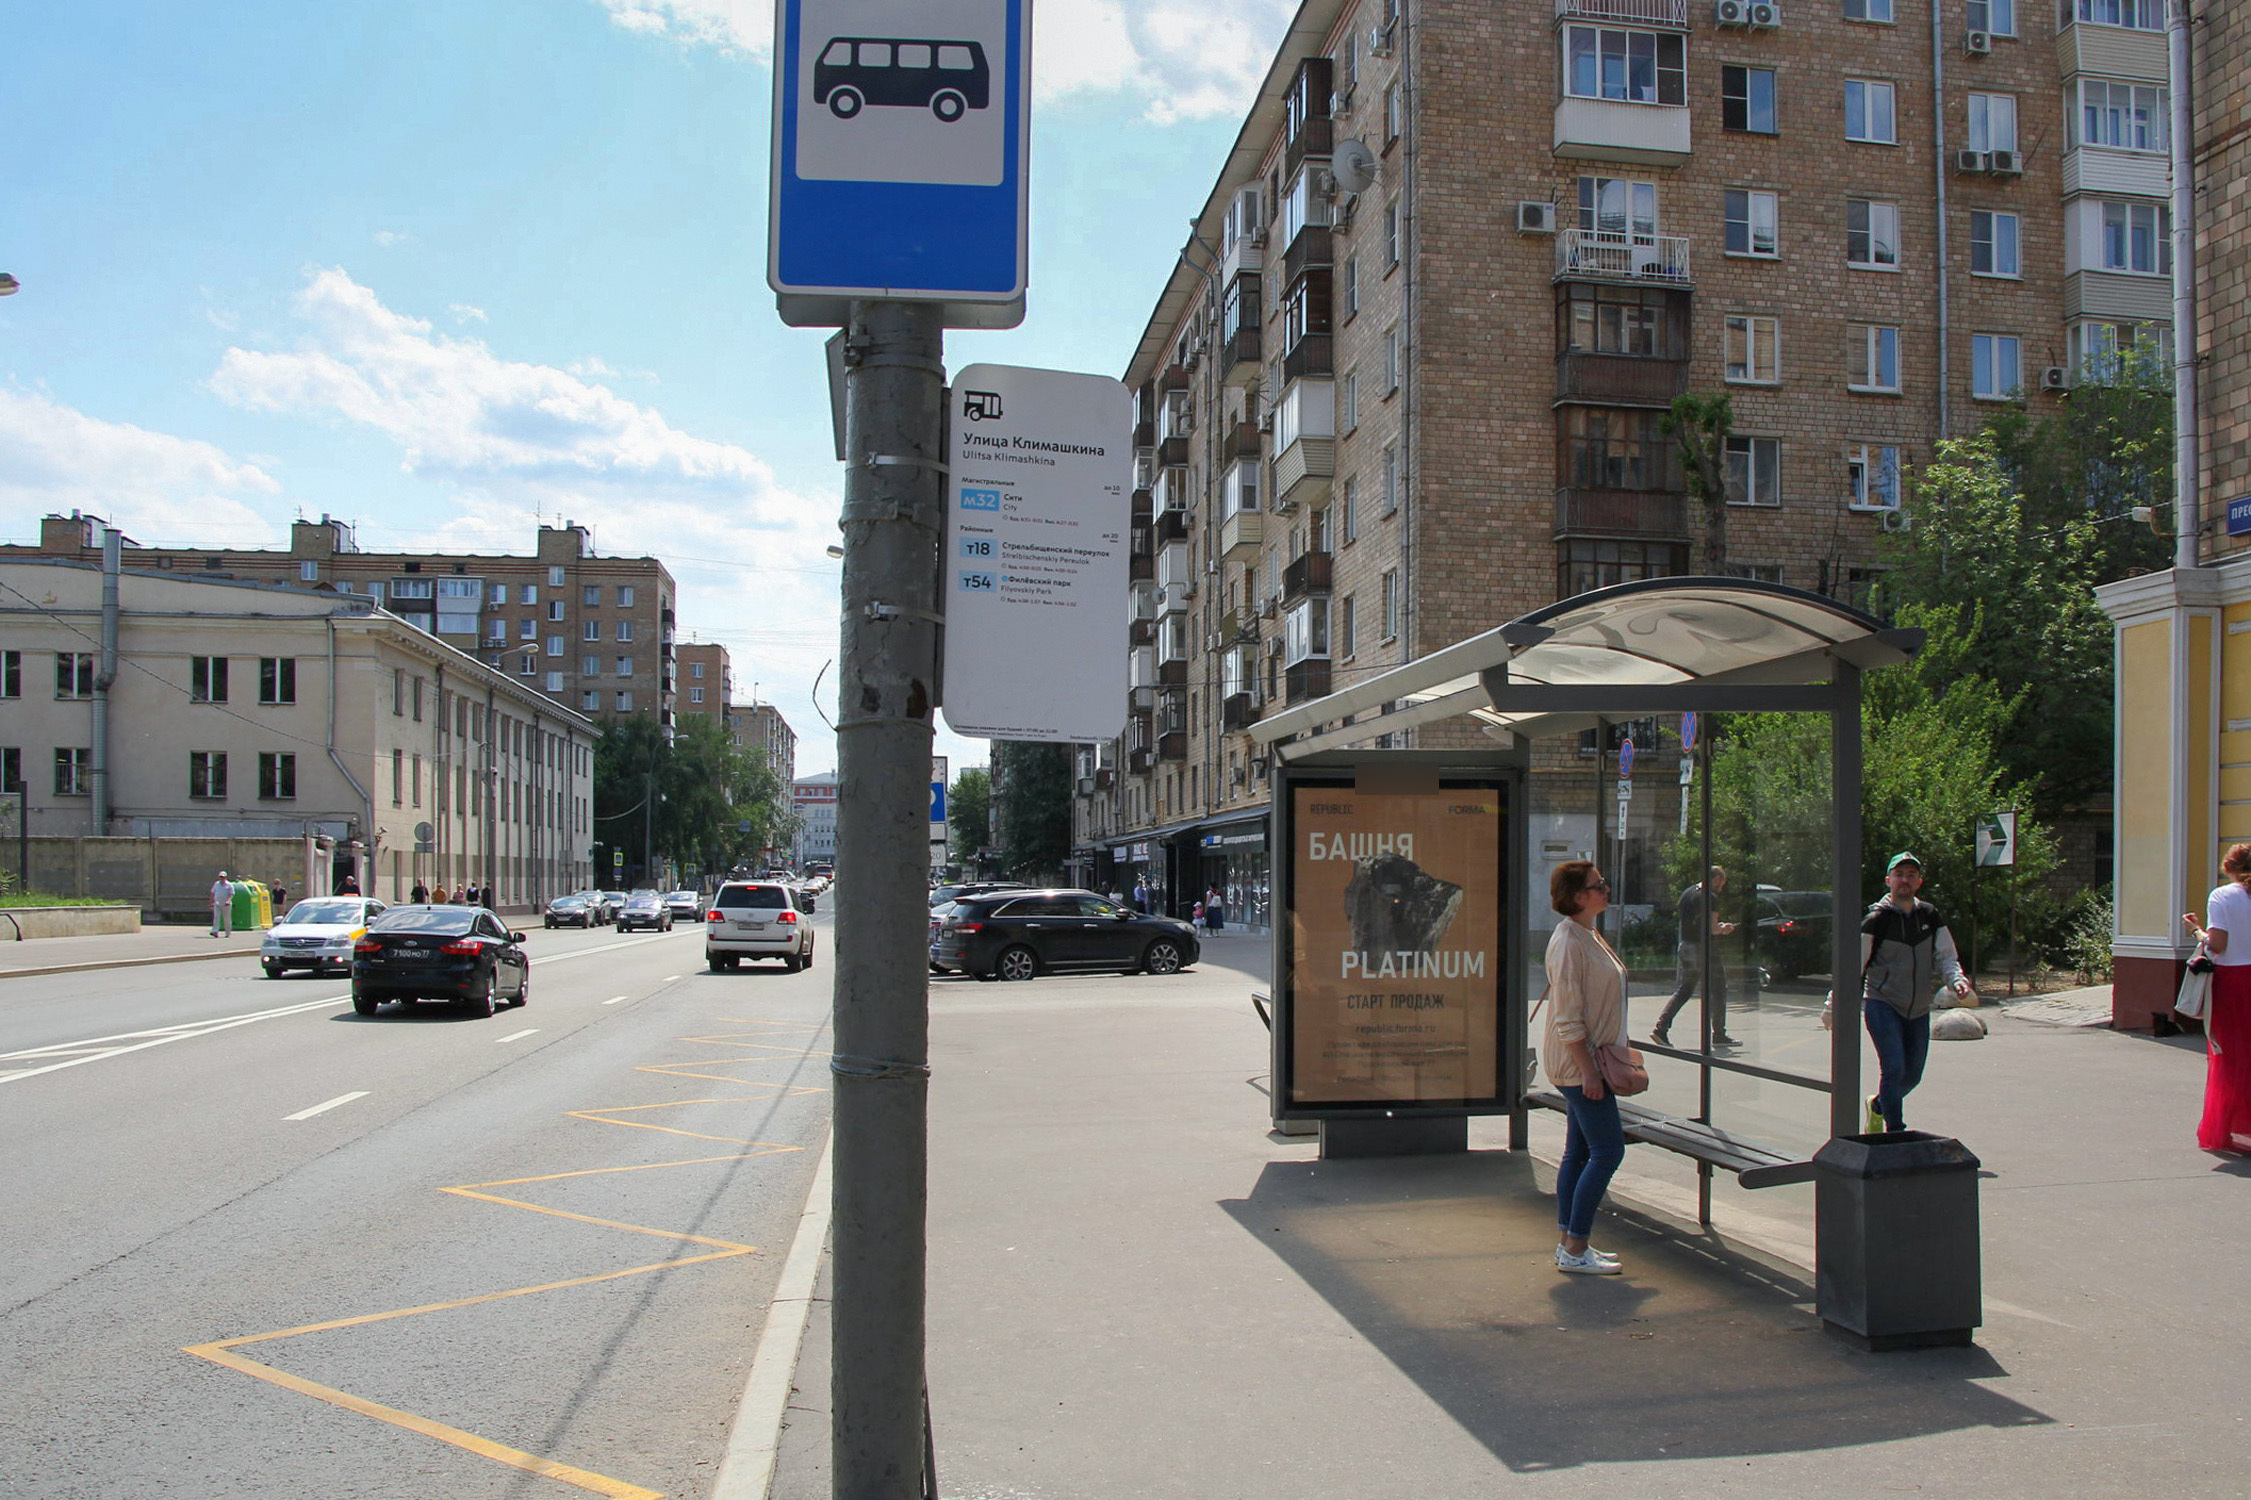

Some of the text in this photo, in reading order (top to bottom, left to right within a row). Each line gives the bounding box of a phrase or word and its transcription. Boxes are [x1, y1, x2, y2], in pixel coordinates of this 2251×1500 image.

[963, 432, 1105, 457] Улица Климашкина
[962, 449, 1055, 466] Ulitsa Klimashkina
[961, 476, 1015, 487] Магистральные
[963, 492, 996, 508] м32
[1003, 493, 1022, 502] Сити
[1003, 503, 1018, 512] City
[966, 542, 990, 556] т18
[1002, 541, 1110, 558] Стрельбищенский переулок
[1059, 556, 1090, 565] Pereulok
[963, 575, 992, 589] т54
[1053, 579, 1071, 587] парк
[1036, 587, 1052, 595] Park
[1310, 803, 1354, 815] REPUBLIC
[1448, 805, 1486, 814] FORMA
[1309, 832, 1414, 861] БАШНЯ
[1341, 951, 1485, 980] PLATINUM
[1347, 993, 1445, 1010] СТАРТ ПРОДАЖ
